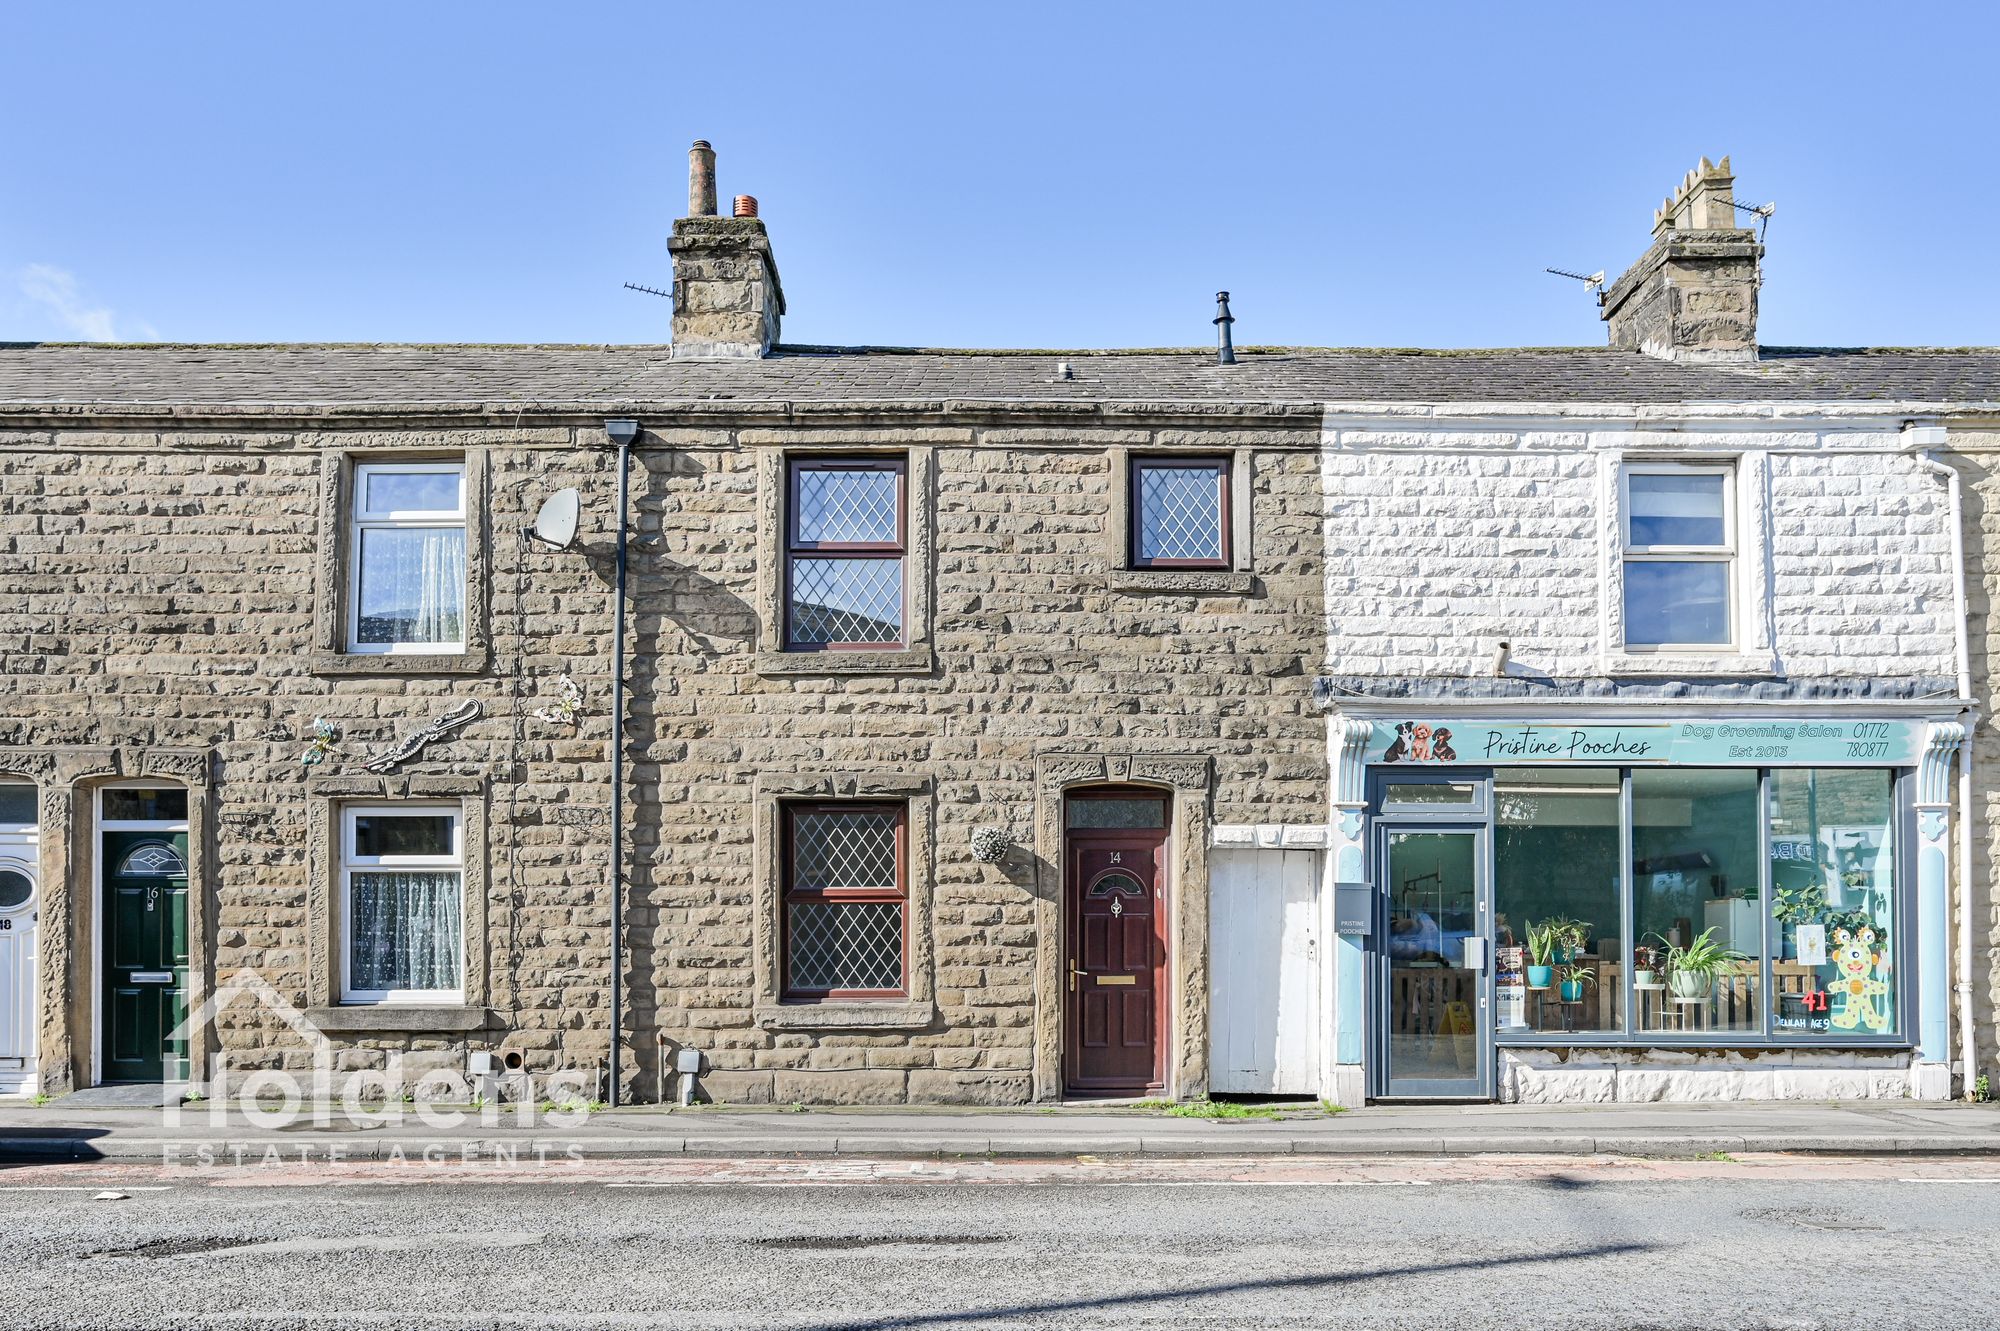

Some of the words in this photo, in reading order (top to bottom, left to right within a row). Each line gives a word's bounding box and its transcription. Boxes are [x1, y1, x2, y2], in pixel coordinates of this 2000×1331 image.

[1681, 724, 1714, 740] Dog
[1717, 724, 1795, 740] Grooming
[1798, 723, 1842, 738] Salon
[1852, 722, 1889, 739] 01772
[1483, 726, 1562, 758] Pristine
[1566, 730, 1651, 758] Pooches
[1846, 741, 1889, 758] 780877
[1728, 745, 1753, 758] Est
[1755, 745, 1788, 758] 2013
[1109, 851, 1121, 864] 14
[146, 886, 159, 899] 16
[1801, 990, 1828, 1012] 41
[1810, 1018, 1823, 1029] AGE
[1823, 1018, 1831, 1030] 9
